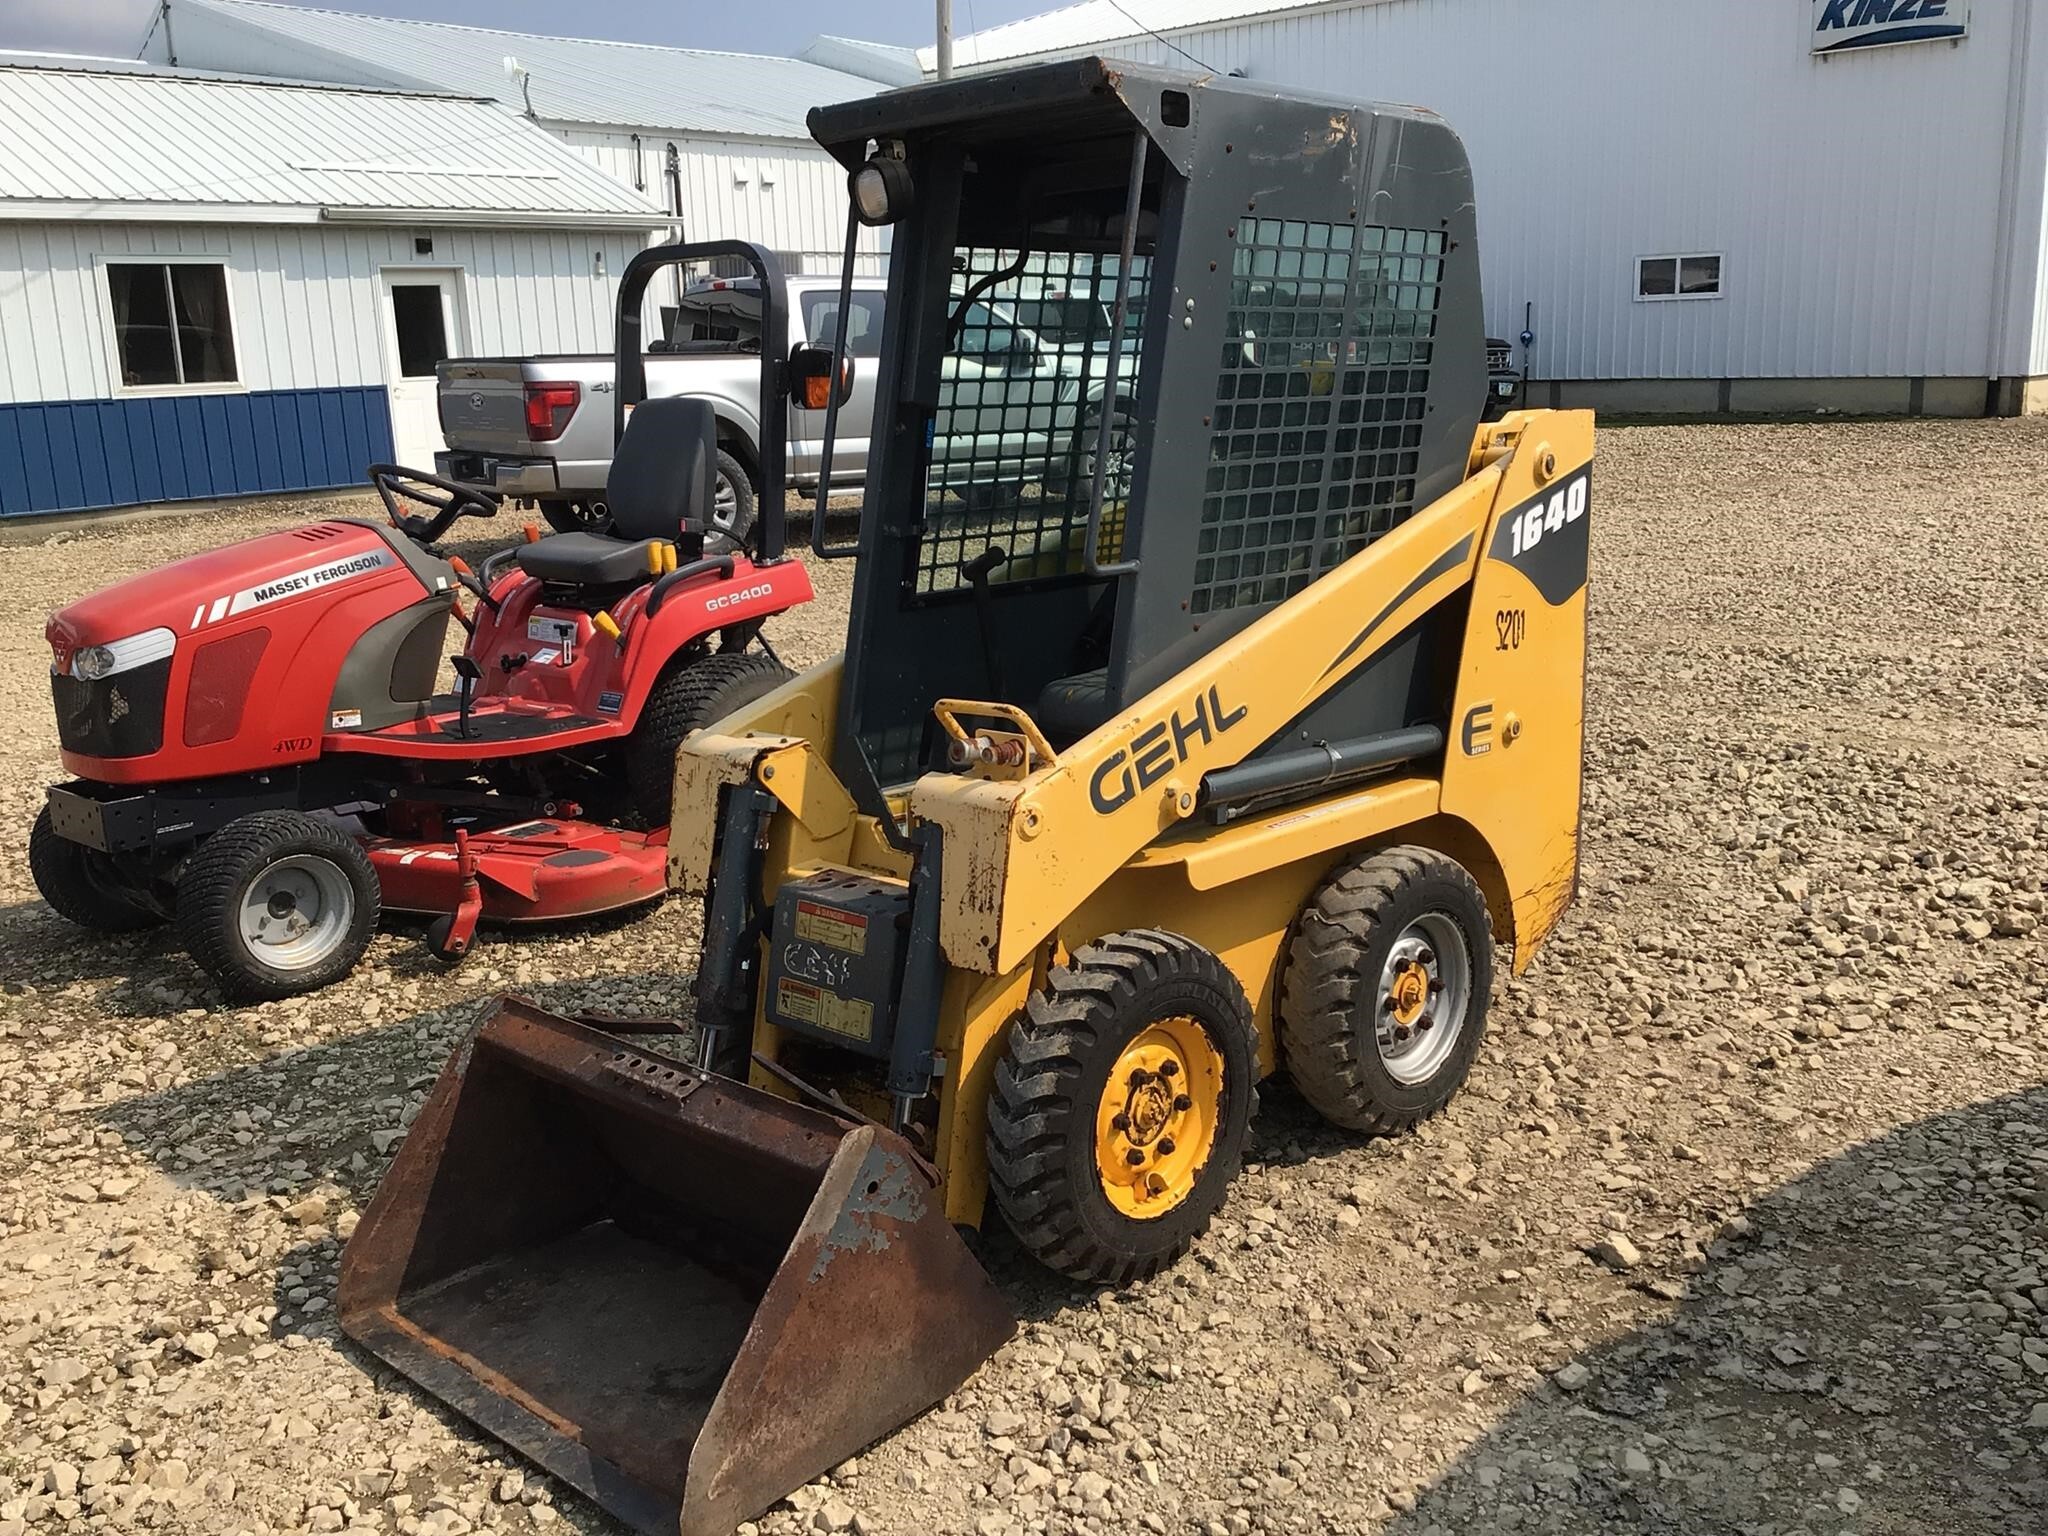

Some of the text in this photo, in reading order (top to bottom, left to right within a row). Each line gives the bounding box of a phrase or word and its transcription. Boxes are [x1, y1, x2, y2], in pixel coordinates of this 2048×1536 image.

[1816, 0, 1948, 31] KINZE
[1511, 475, 1587, 558] 1640
[254, 555, 381, 602] MASSEY FERGUSON
[706, 583, 772, 611] GC2400
[272, 737, 312, 752] 4WD
[1090, 684, 1247, 815] GEHL
[1462, 704, 1493, 756] E
